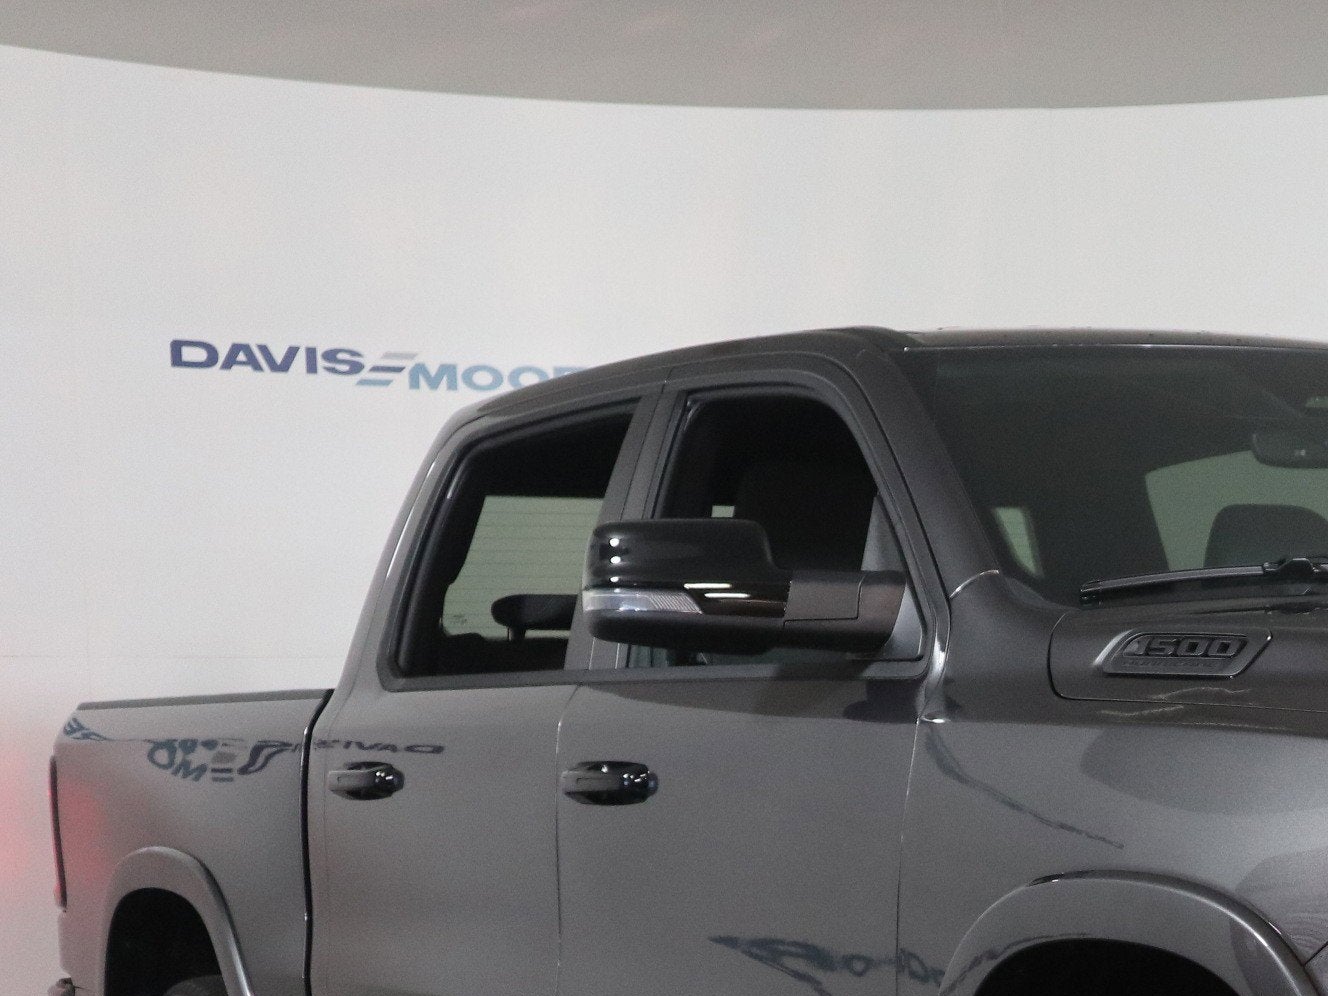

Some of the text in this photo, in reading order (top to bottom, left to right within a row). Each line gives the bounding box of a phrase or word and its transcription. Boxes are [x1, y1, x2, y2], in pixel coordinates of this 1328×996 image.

[169, 339, 589, 391] DAVIS MOO
[1134, 636, 1245, 659] 1500
